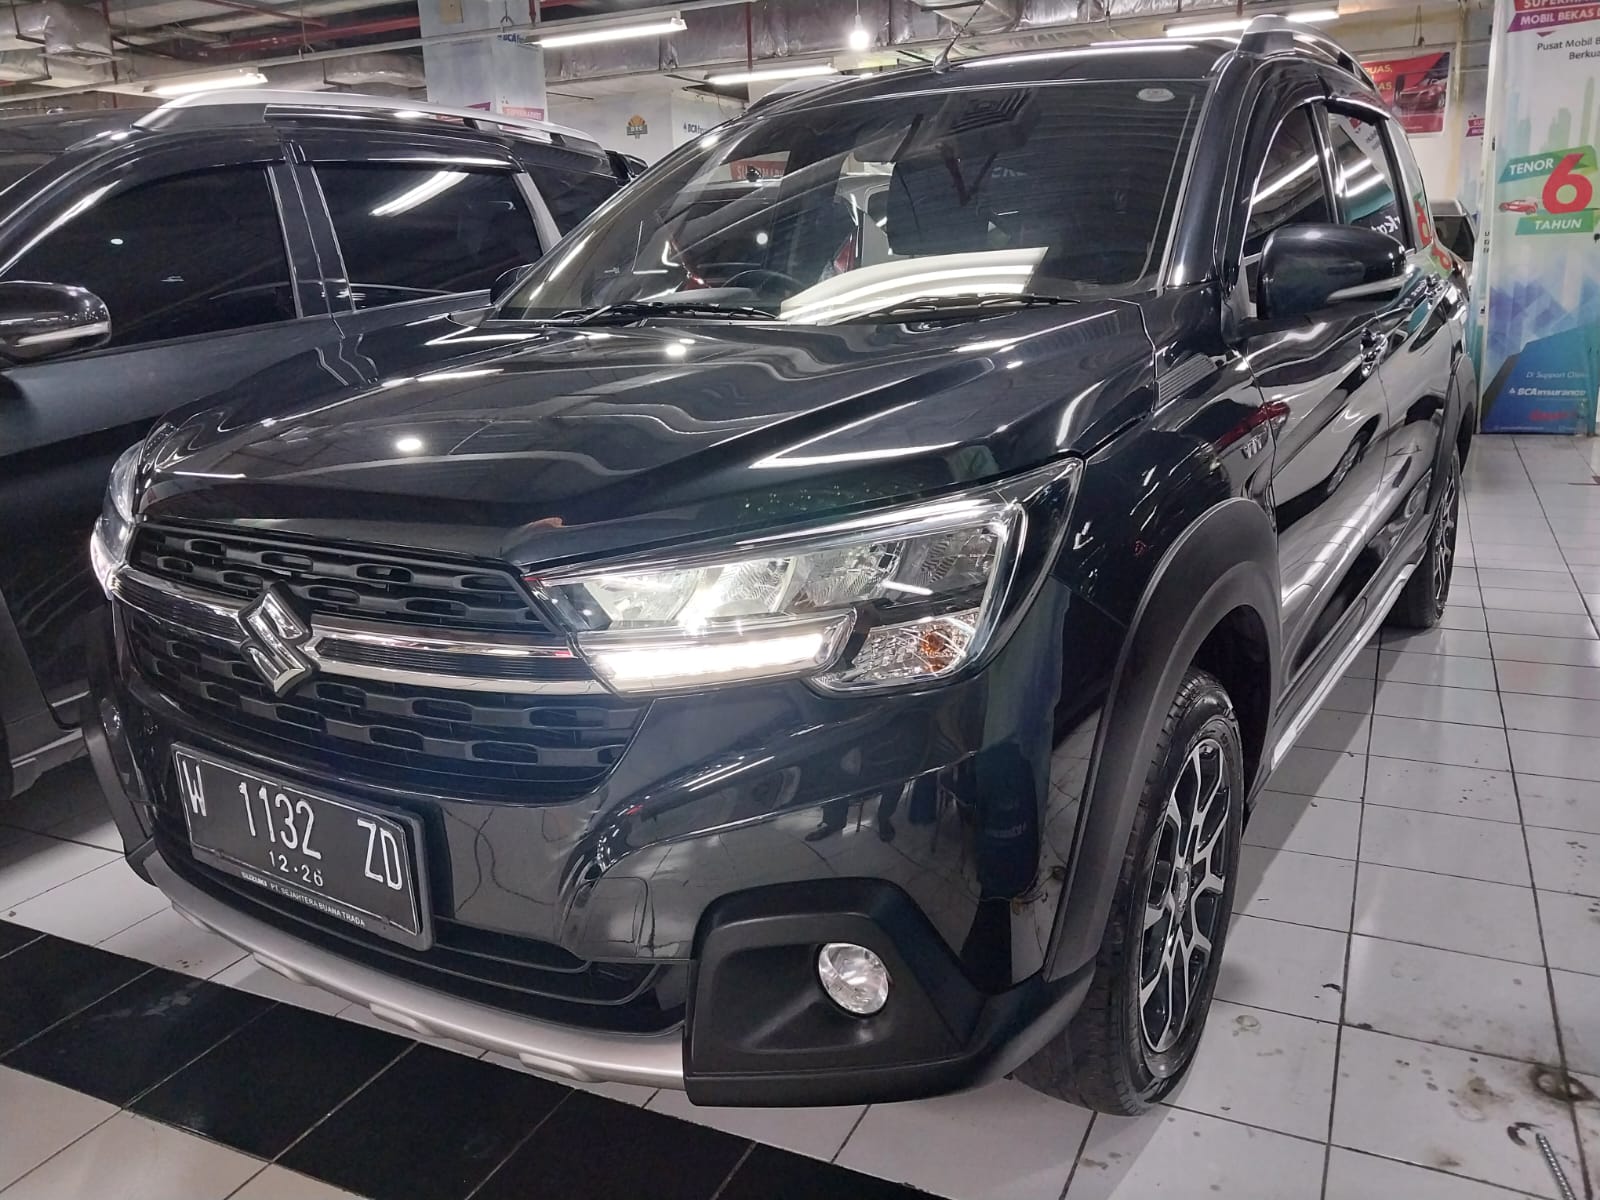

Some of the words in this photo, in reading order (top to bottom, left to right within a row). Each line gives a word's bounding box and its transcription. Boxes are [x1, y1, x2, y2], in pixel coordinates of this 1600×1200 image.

[1520, 12, 1555, 25] MOBIL
[1557, 8, 1594, 21] BEKAS
[1537, 40, 1563, 51] Pusat
[1565, 37, 1592, 48] Mobil
[1509, 158, 1554, 175] TENOR
[1542, 153, 1593, 215] 6
[1535, 218, 1582, 230] TAHUN
[182, 760, 207, 816] W
[238, 781, 322, 860] 1132
[357, 818, 402, 890] ZD
[341, 911, 366, 927] TRADA
